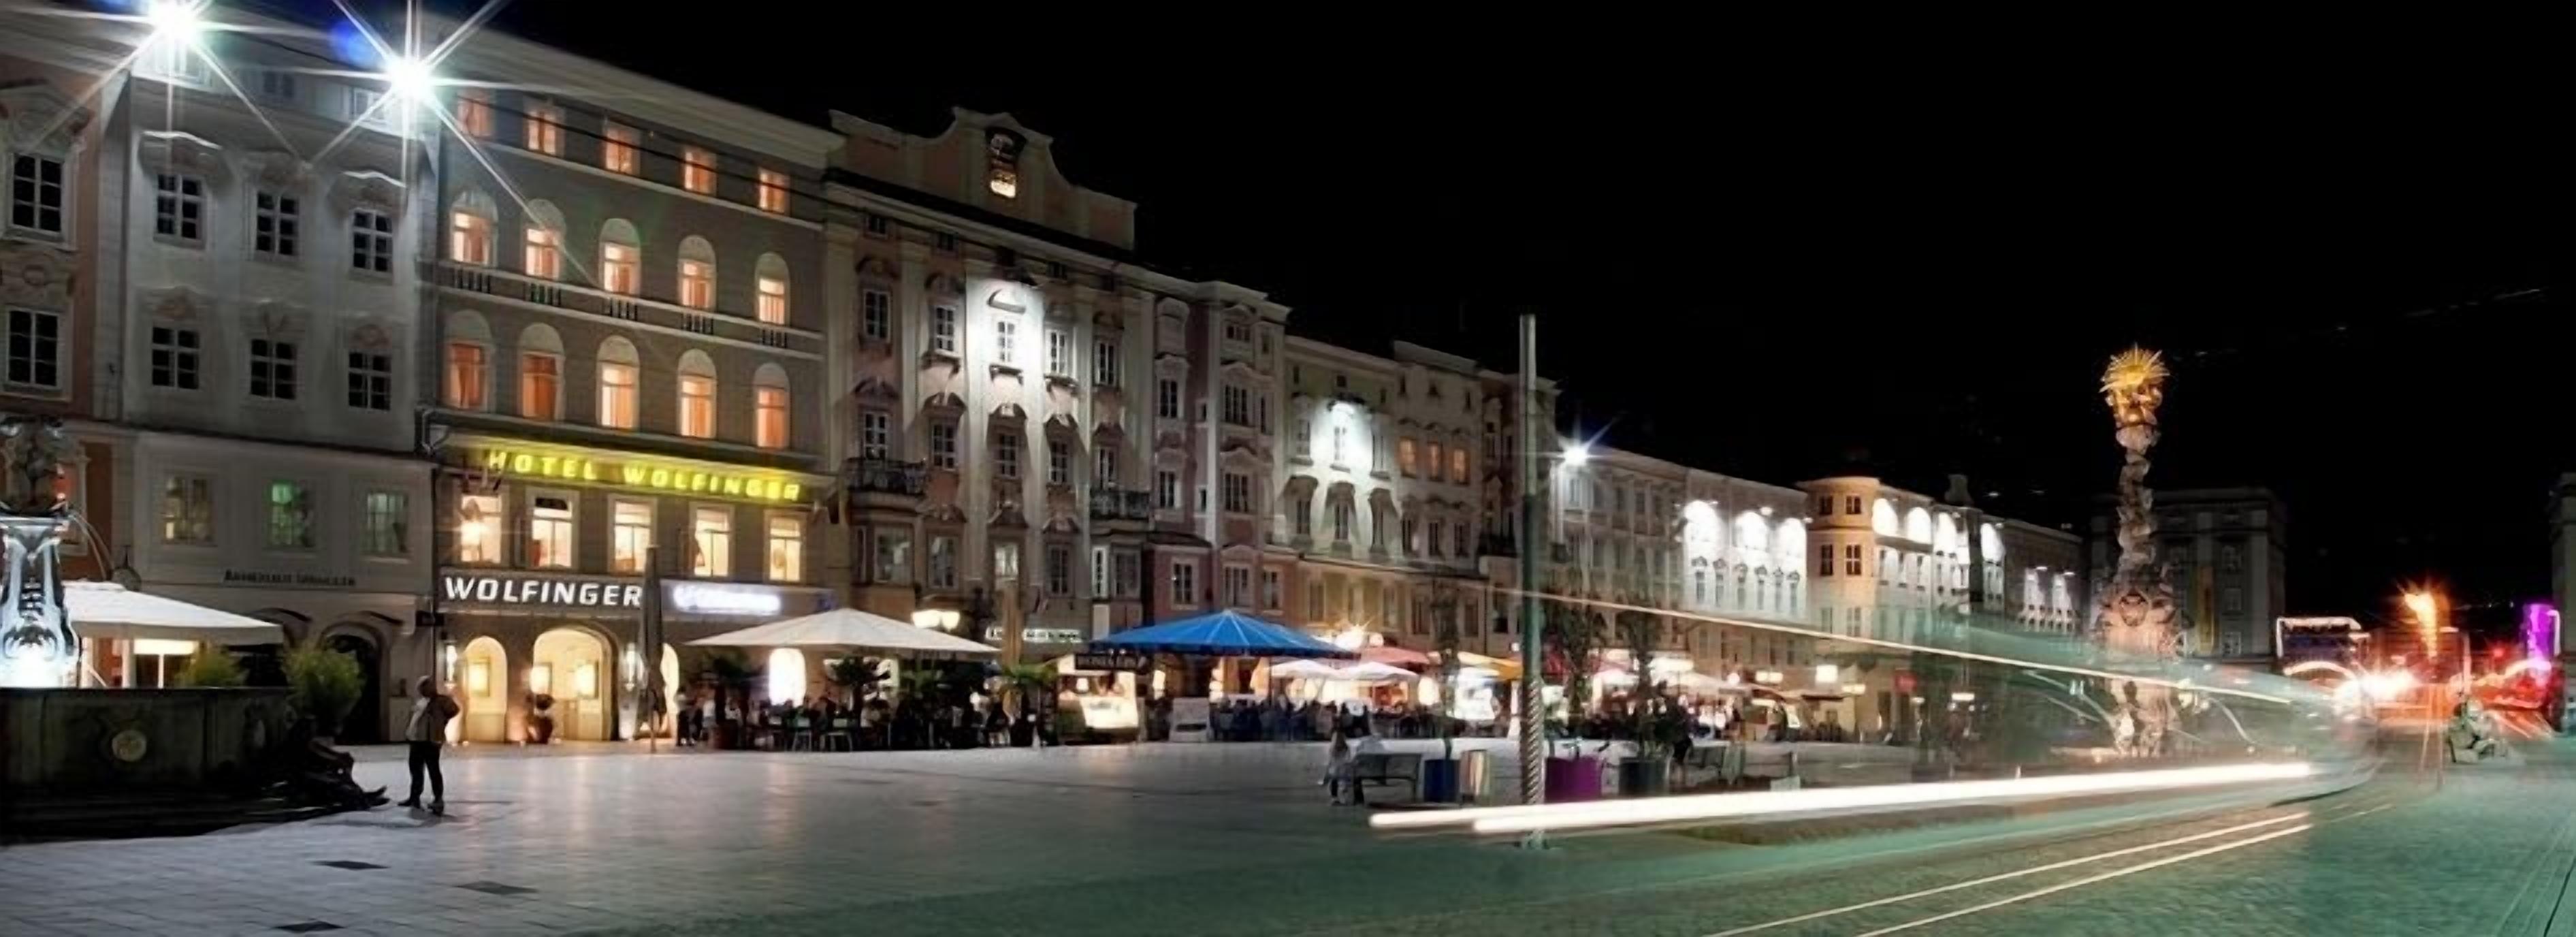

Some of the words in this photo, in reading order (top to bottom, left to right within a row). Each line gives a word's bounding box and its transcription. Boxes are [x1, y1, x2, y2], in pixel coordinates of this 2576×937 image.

[488, 451, 598, 481] HOTEL
[623, 466, 801, 501] WOLFINGER
[445, 577, 643, 607] WOLFINGER
